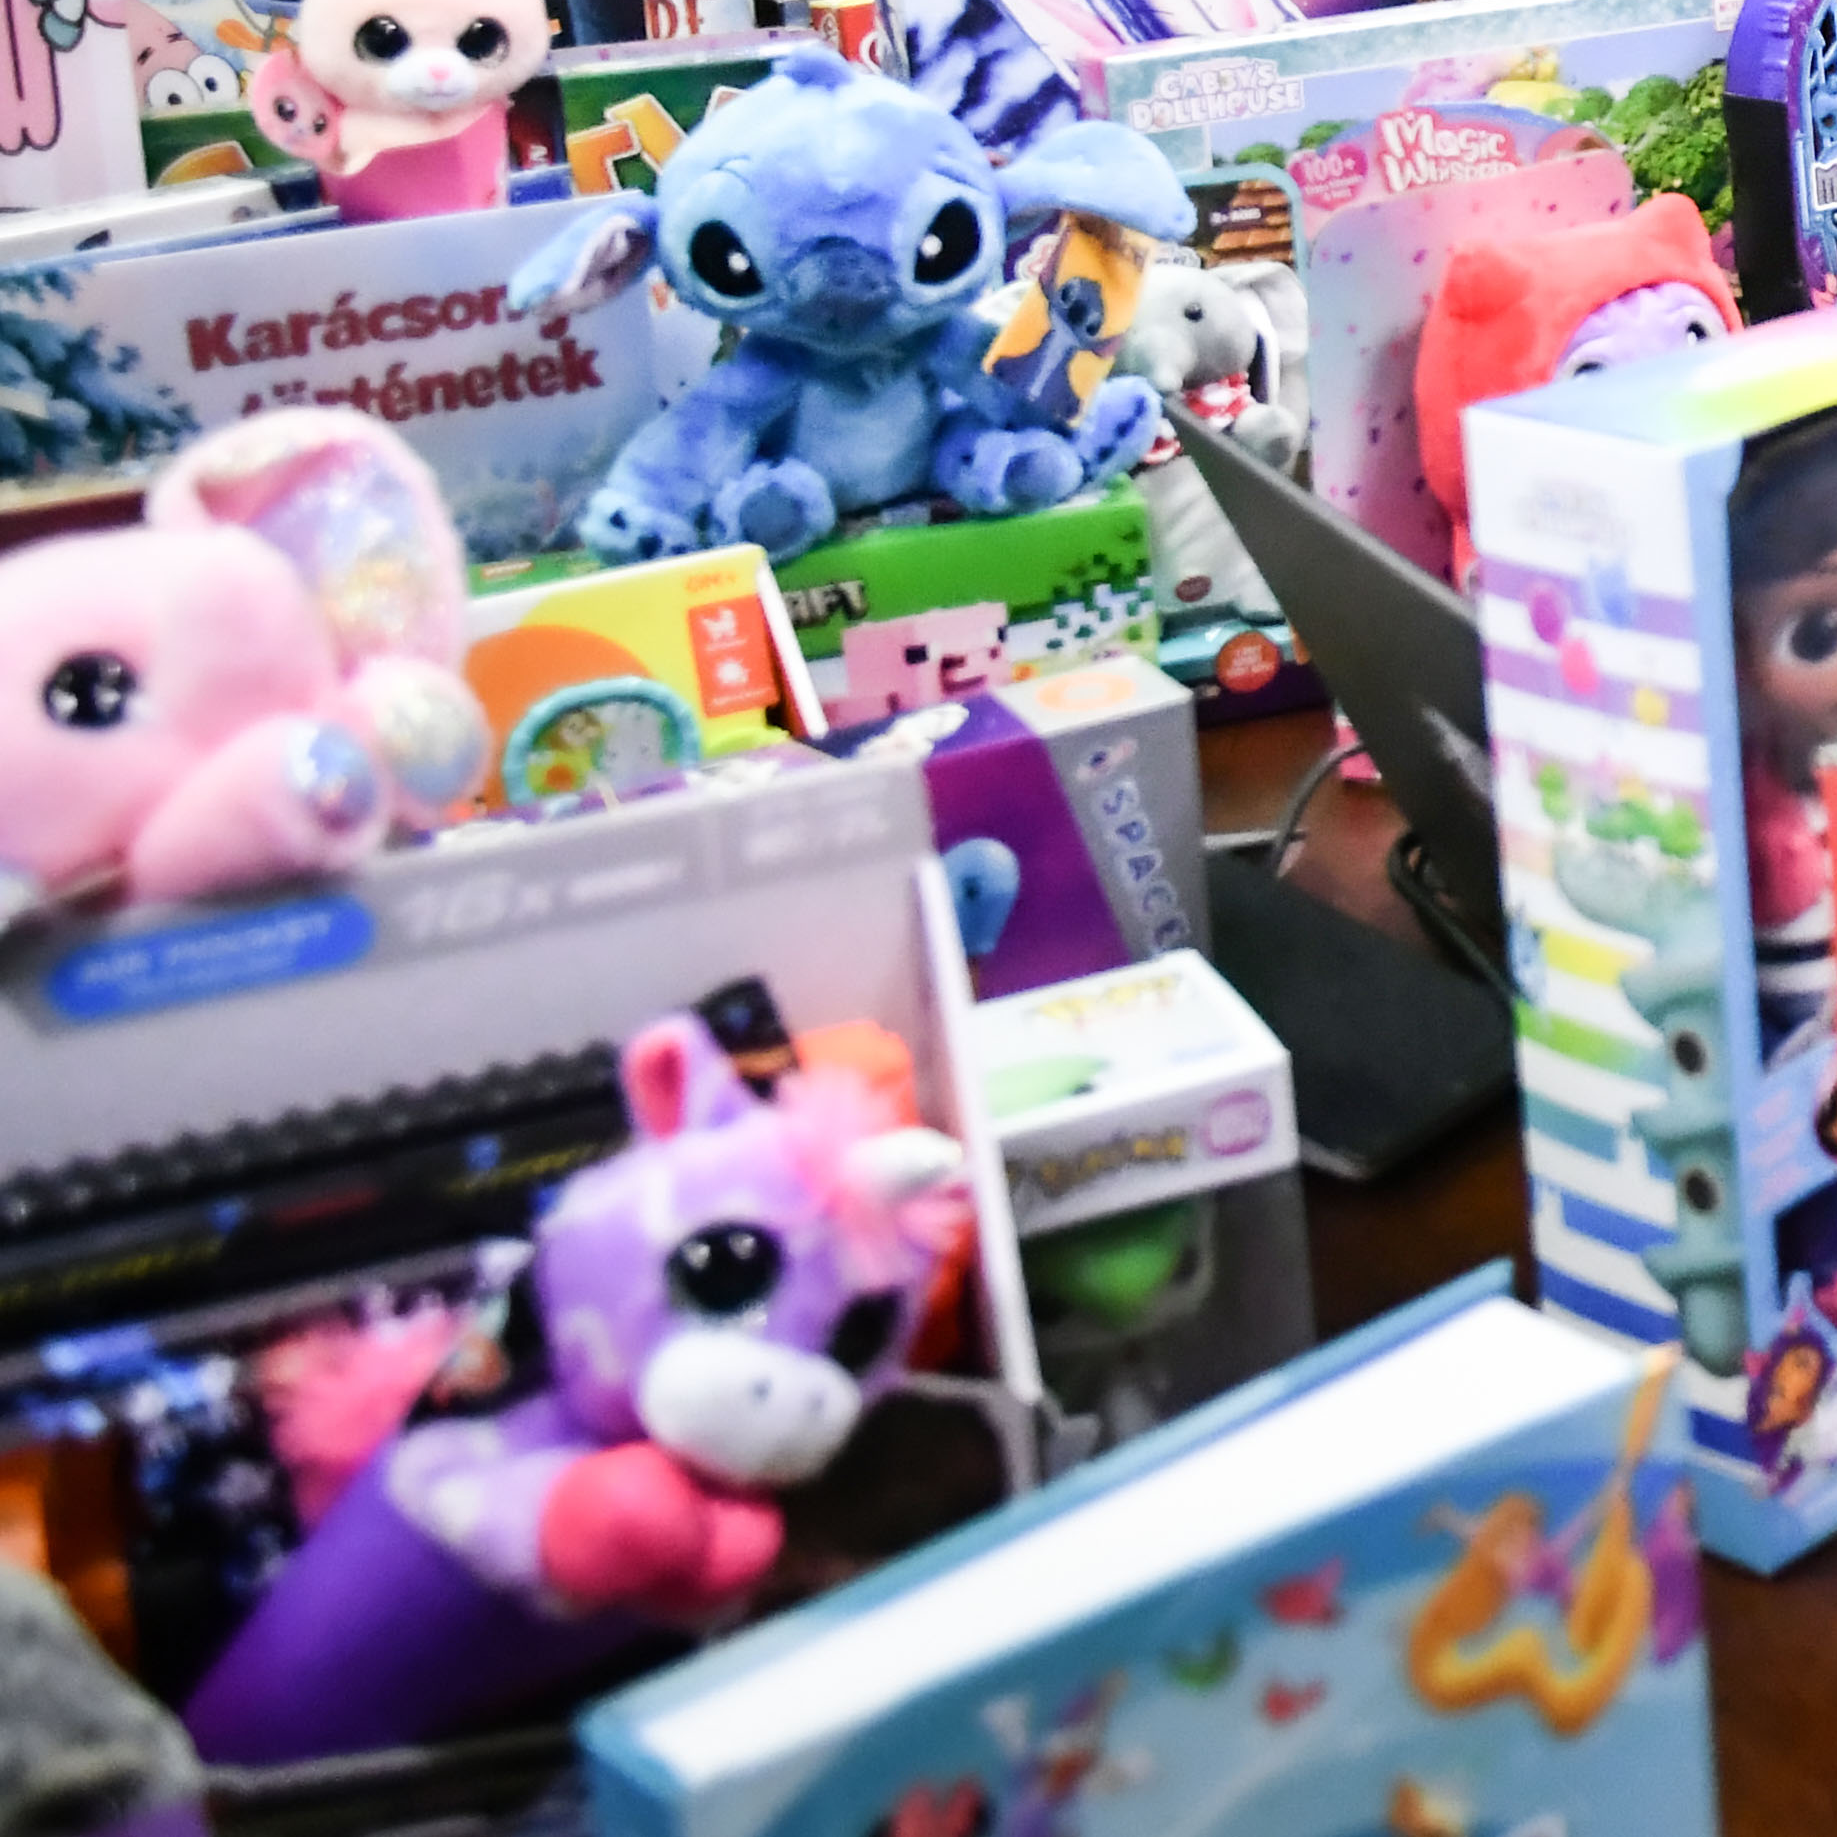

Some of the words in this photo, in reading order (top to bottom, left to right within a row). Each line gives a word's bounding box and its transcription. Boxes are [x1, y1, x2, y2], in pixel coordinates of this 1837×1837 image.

[1131, 81, 1301, 130] DOLLHOUSE
[1381, 110, 1507, 163] Magic
[187, 289, 570, 373] Karácson
[241, 338, 604, 423] ténetek
